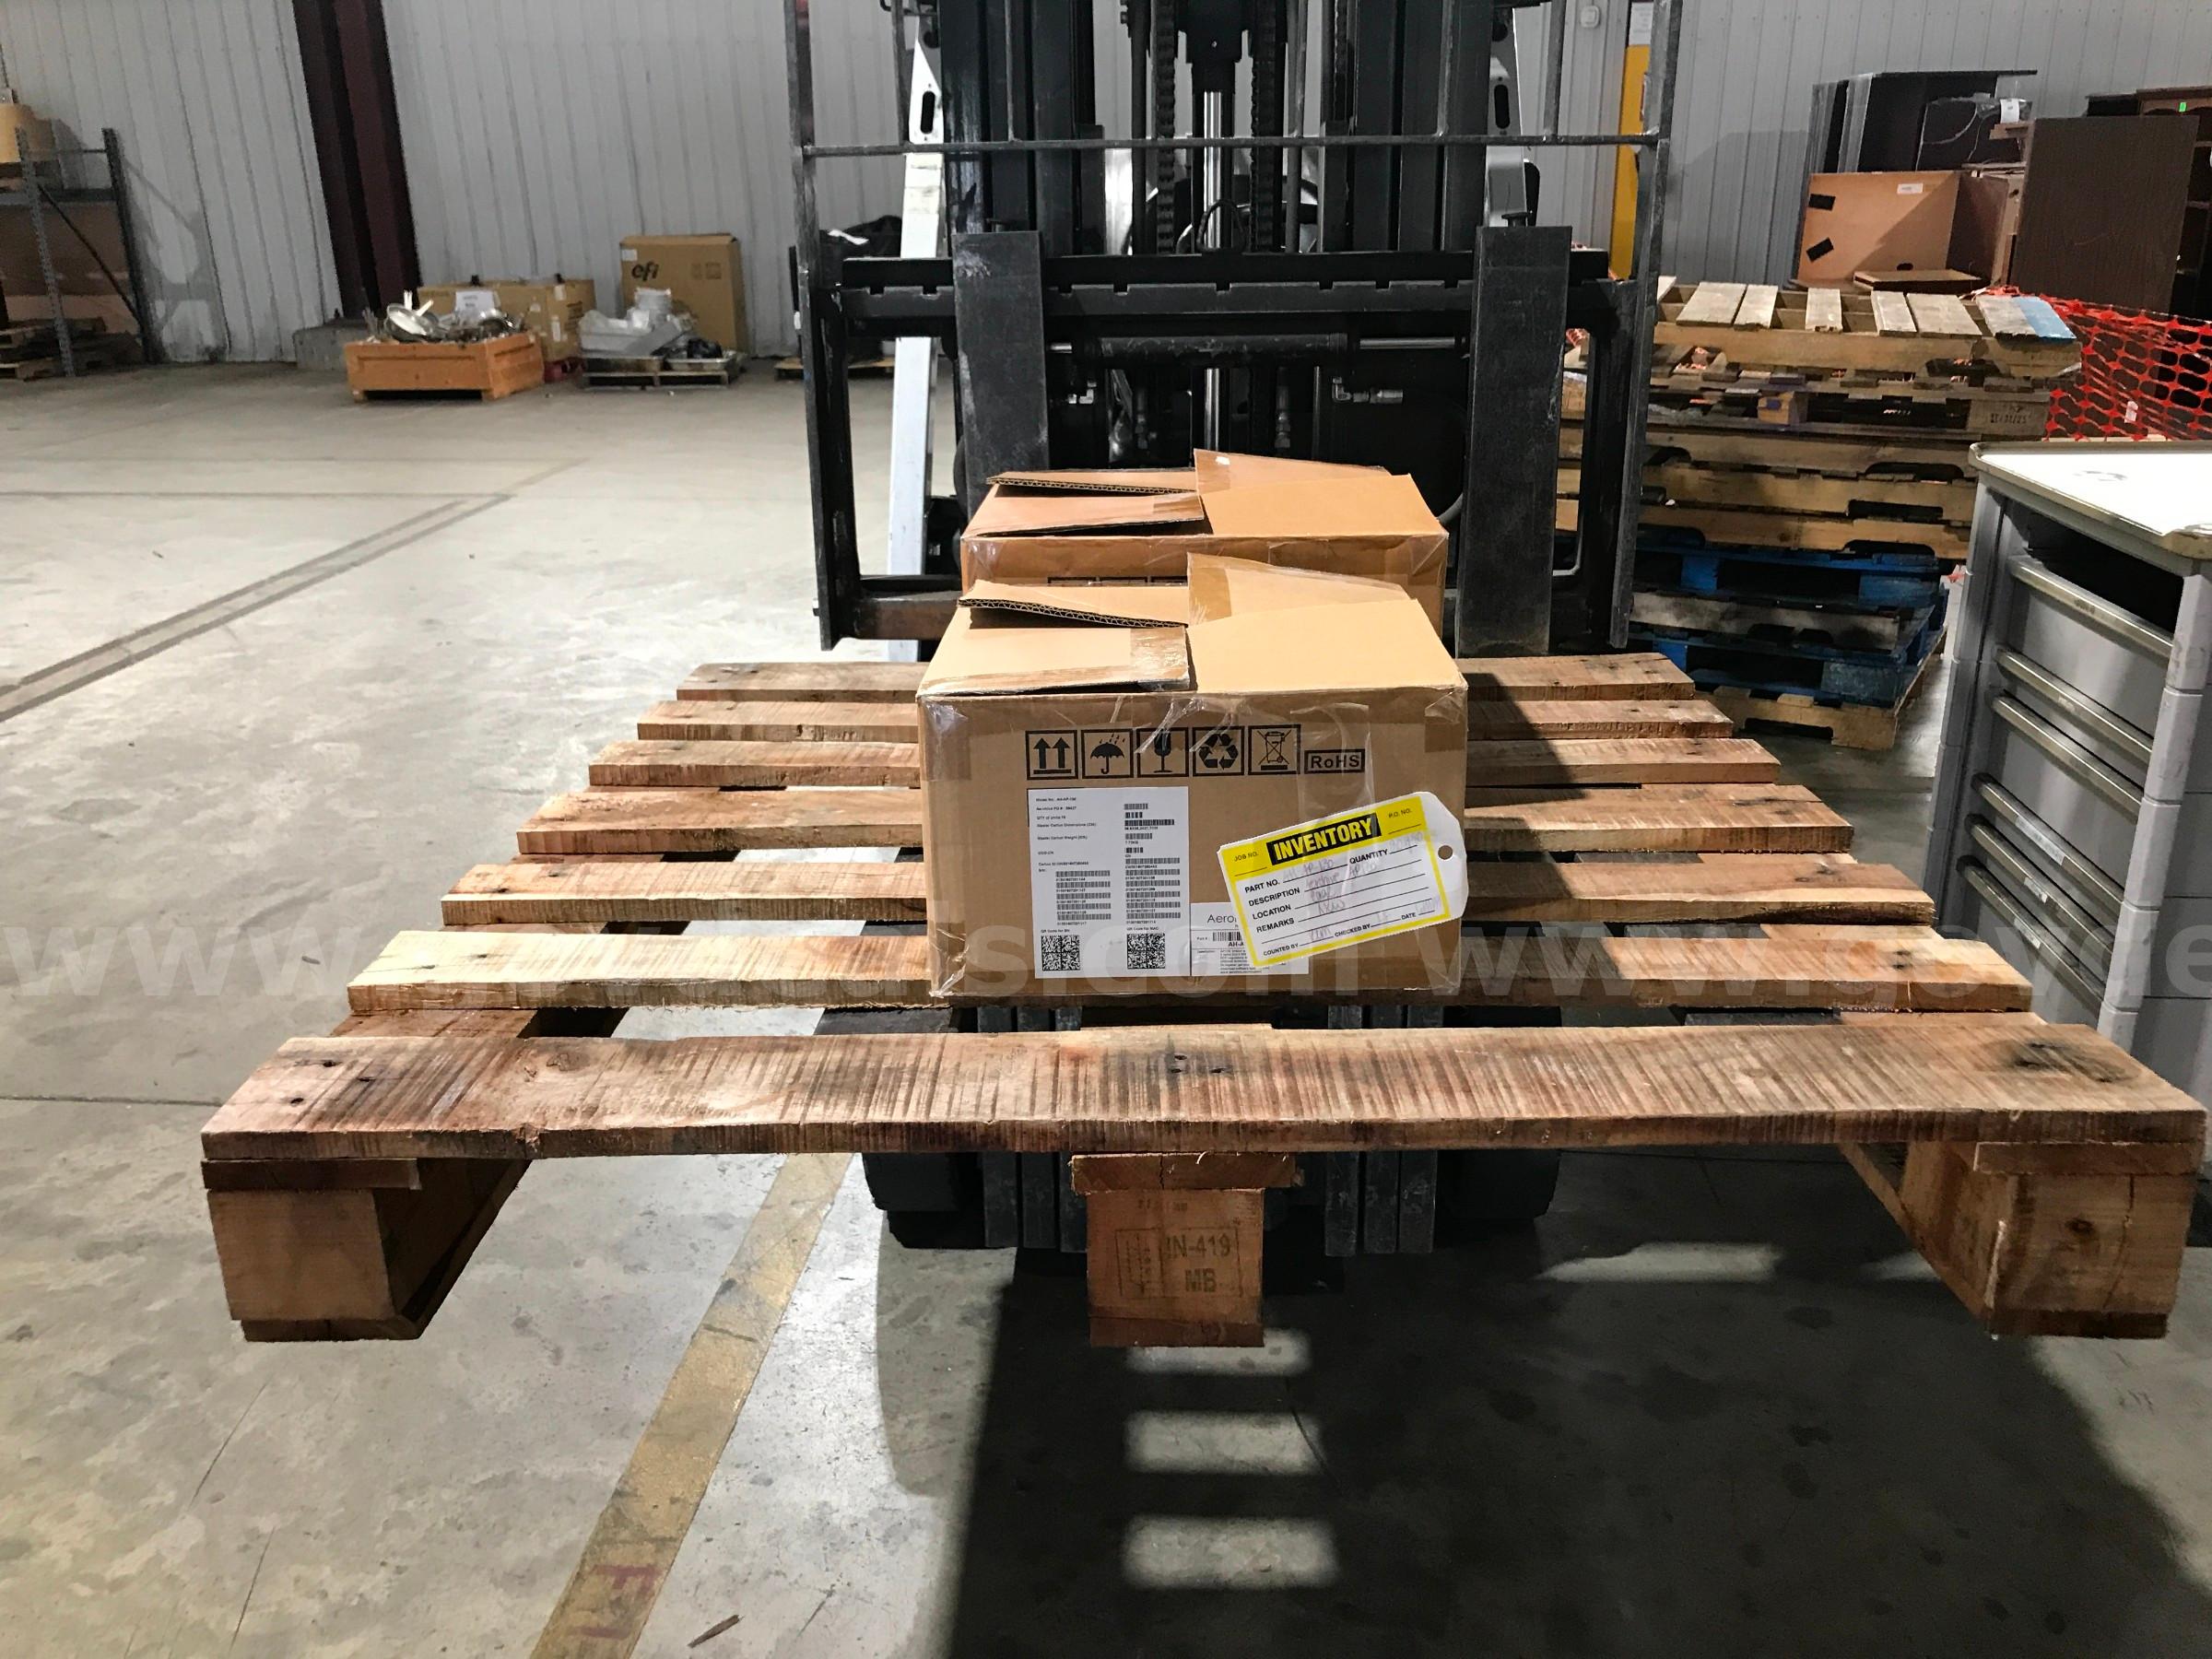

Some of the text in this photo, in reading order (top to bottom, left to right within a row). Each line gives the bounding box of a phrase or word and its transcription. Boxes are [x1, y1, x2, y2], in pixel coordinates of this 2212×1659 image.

[1311, 754, 1359, 769] RoHS
[1273, 818, 1371, 861] INVENTORY
[1234, 853, 1247, 862] JOB
[1349, 849, 1388, 865] QUANTITY
[1244, 878, 1280, 894] PART NO.
[1248, 887, 1300, 907] DESCRIPTION
[1206, 913, 1237, 924] Aero
[1253, 903, 1291, 920] LOCATION
[1401, 912, 1417, 921] DATE
[1256, 917, 1295, 933] REMARKS
[1335, 925, 1362, 937] CHECKED
[1264, 944, 1290, 957] COUNTED
